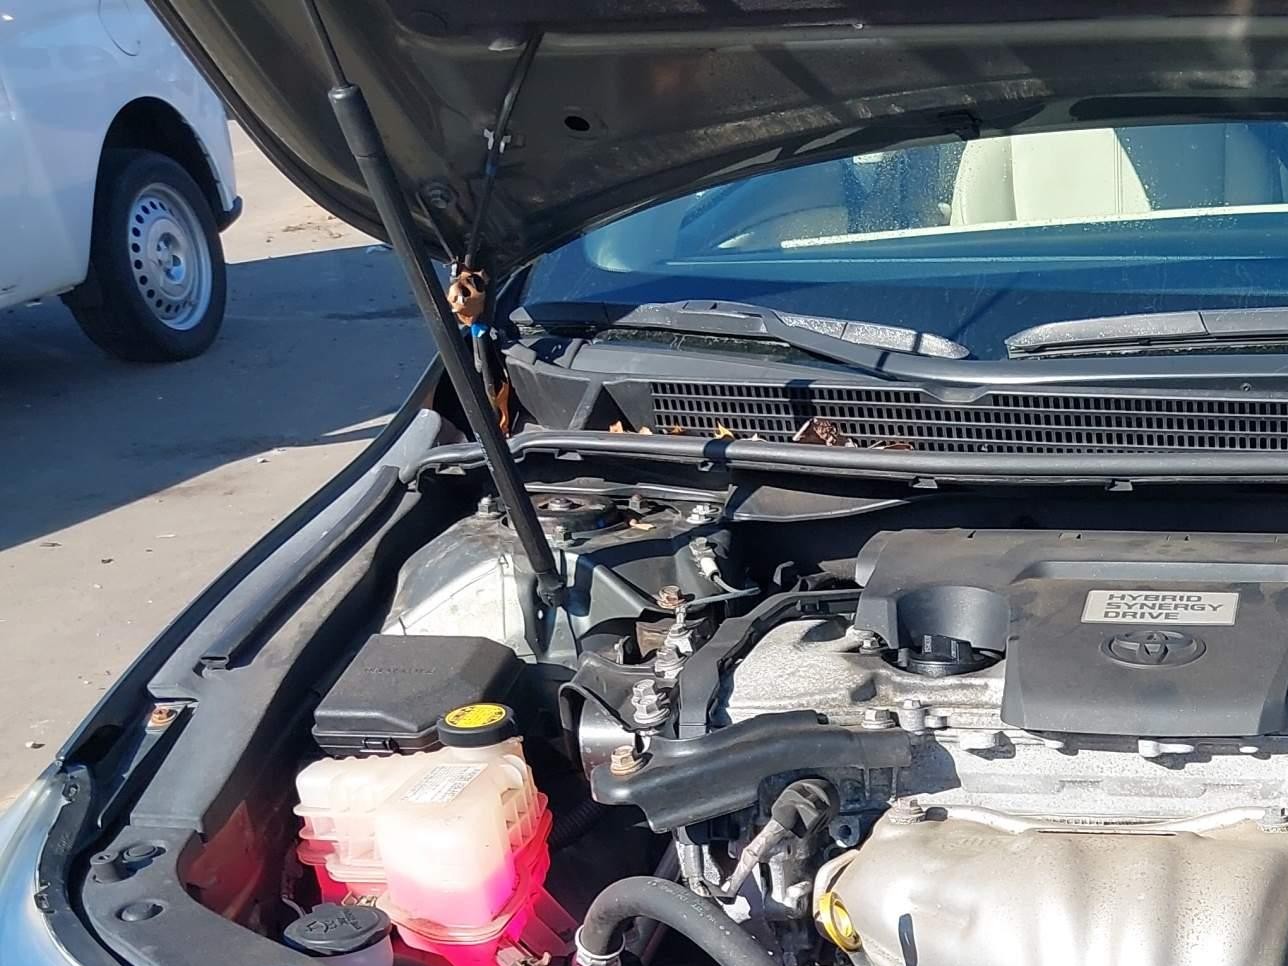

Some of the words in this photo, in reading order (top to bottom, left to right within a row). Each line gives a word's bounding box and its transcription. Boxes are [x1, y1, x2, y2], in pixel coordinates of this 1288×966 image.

[1107, 594, 1203, 602] HYBRID
[1105, 602, 1224, 611] SYNERGY
[1103, 611, 1180, 620] DRIVE
